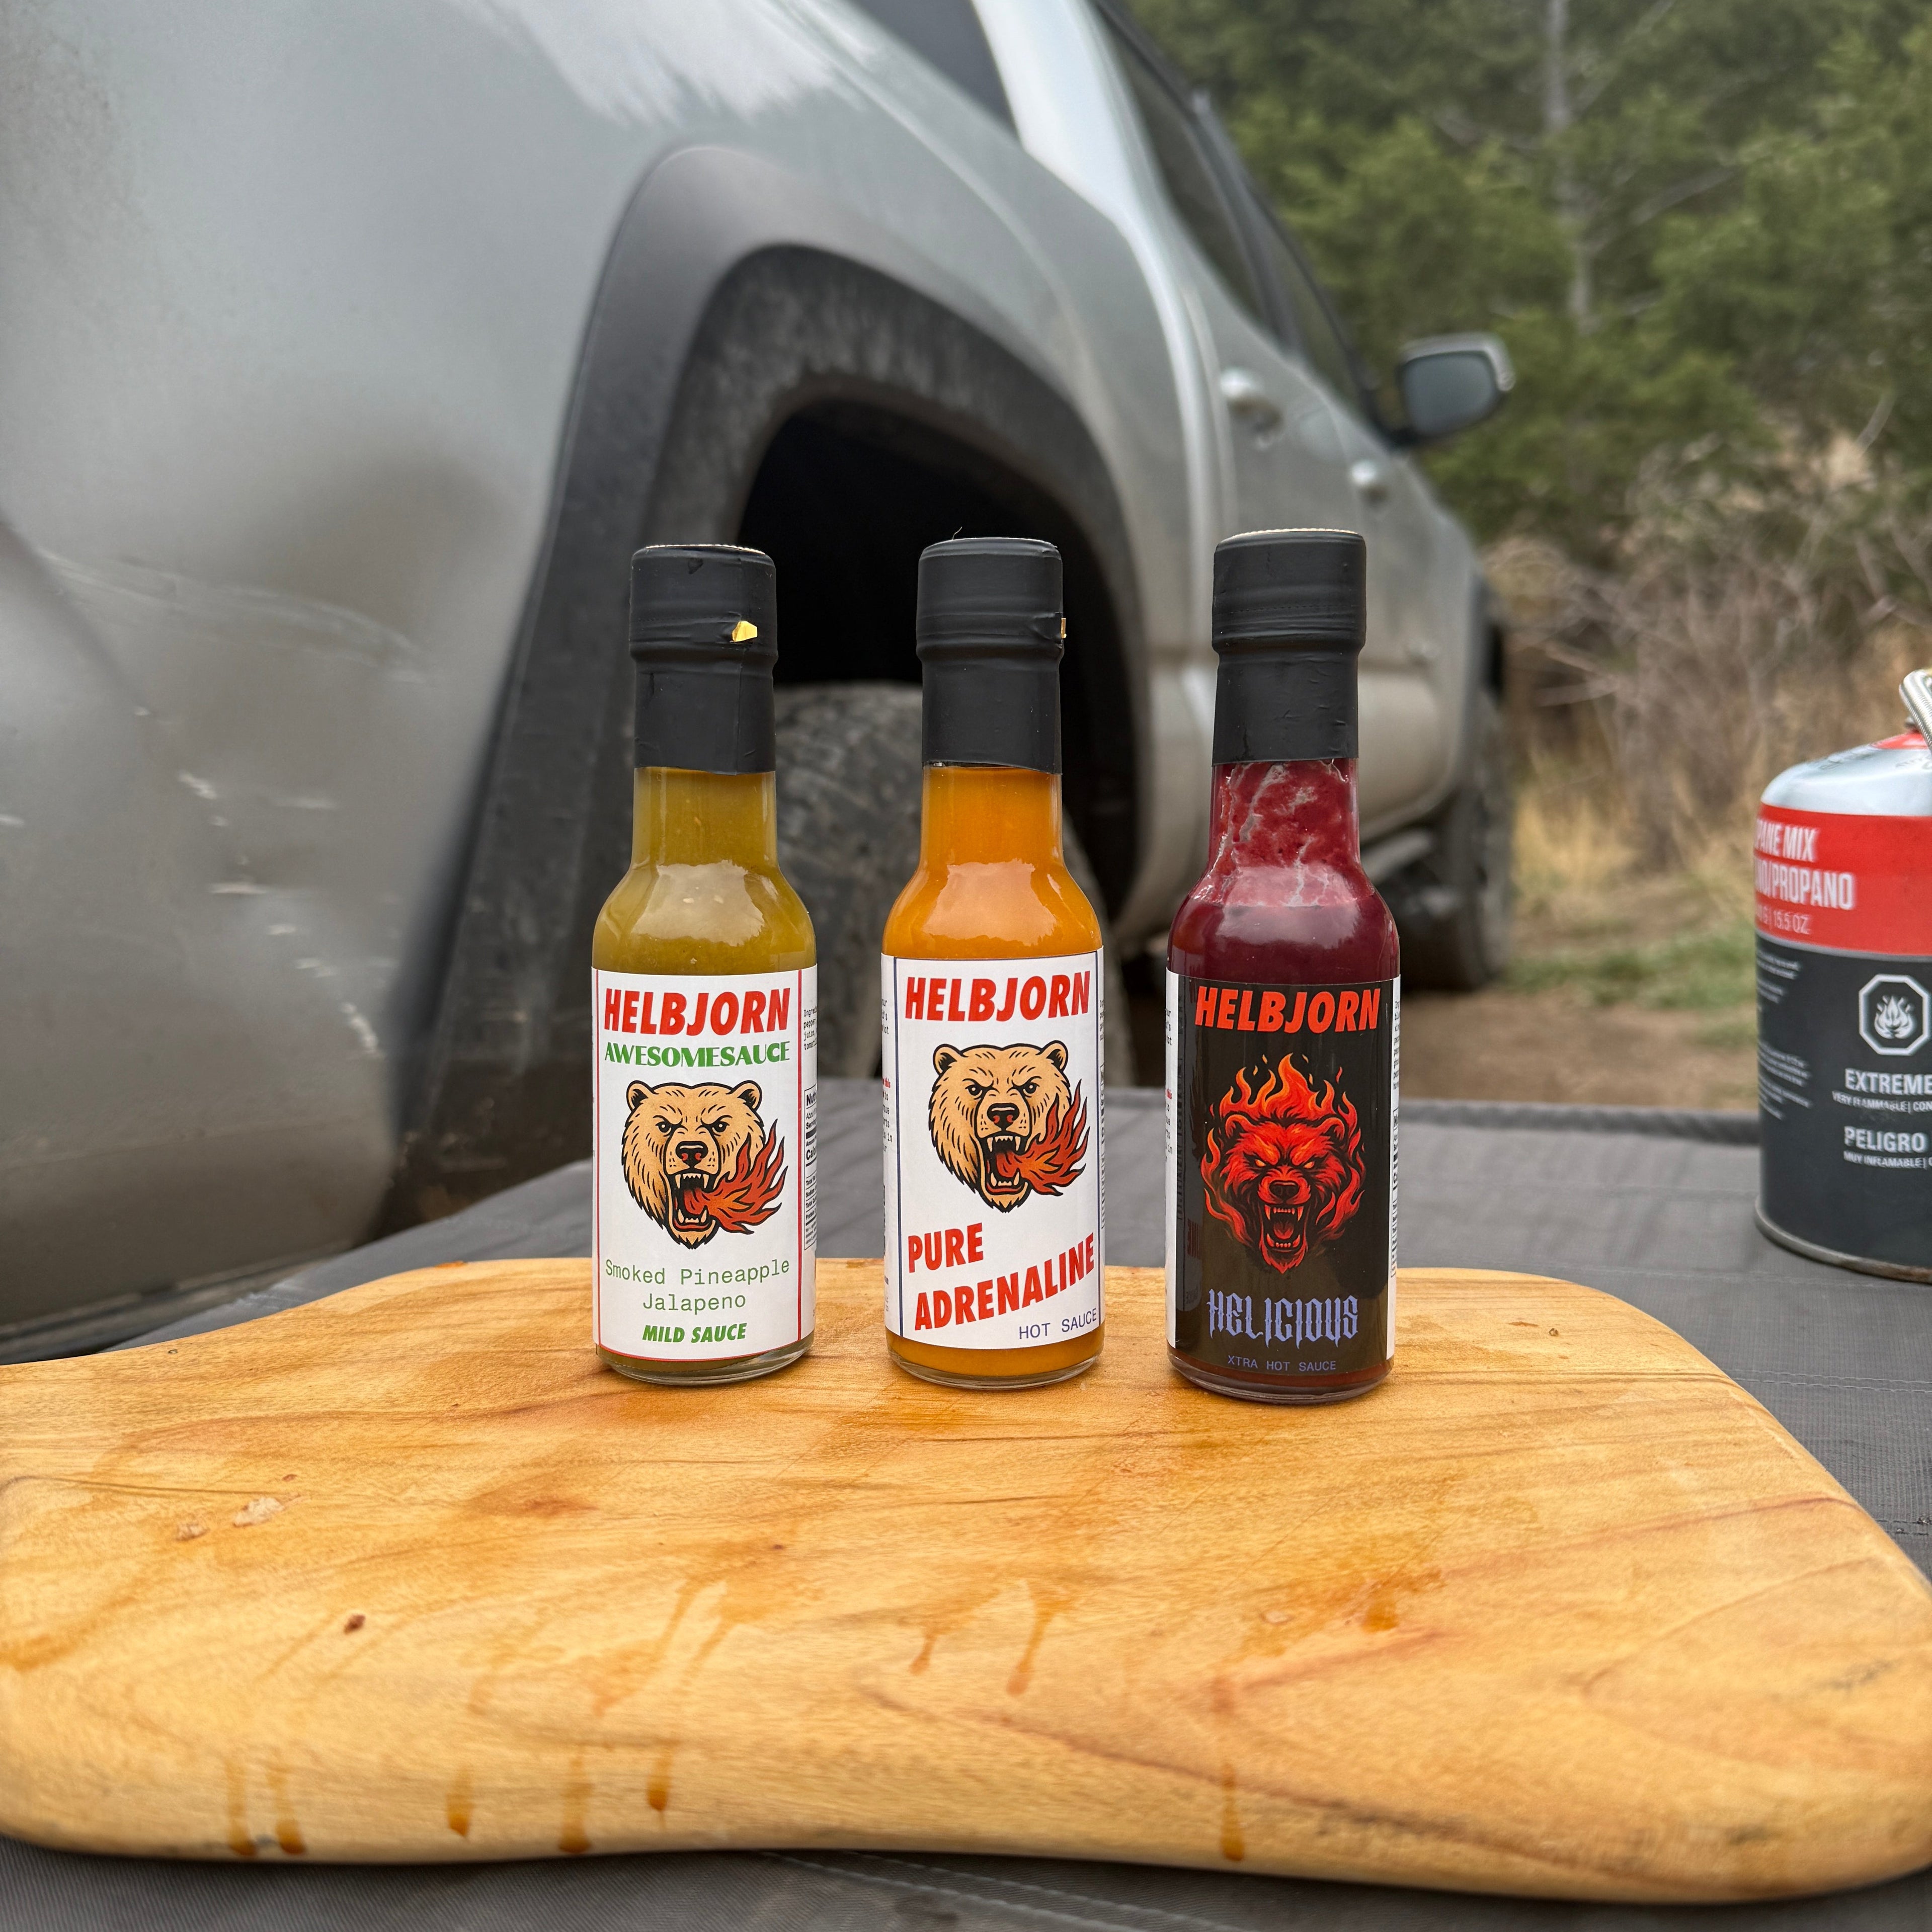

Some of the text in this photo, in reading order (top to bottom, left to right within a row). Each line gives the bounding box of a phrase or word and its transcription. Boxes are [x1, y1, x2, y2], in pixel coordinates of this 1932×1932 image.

[1783, 825, 1818, 862] MIX
[1792, 914, 1811, 934] OZ
[604, 988, 790, 1036] HELBJORN
[904, 971, 1090, 1022] HELBJORN
[1194, 986, 1381, 1033] HELBJORN
[605, 1041, 790, 1067] AWESOMESAUCE
[1844, 1125, 1927, 1153] PELIGRO
[908, 1222, 984, 1273] PURE
[606, 1259, 789, 1285] Smoked Pineapple
[915, 1232, 1094, 1331] ADRENALINE
[643, 1293, 746, 1315] Jalapeno
[1206, 1289, 1358, 1349] HELICIOUS
[642, 1323, 747, 1343] MILD SAUCE
[1019, 1308, 1097, 1339] HOT SAUCE
[1228, 1354, 1336, 1372] XTRA HOT SAUCE
